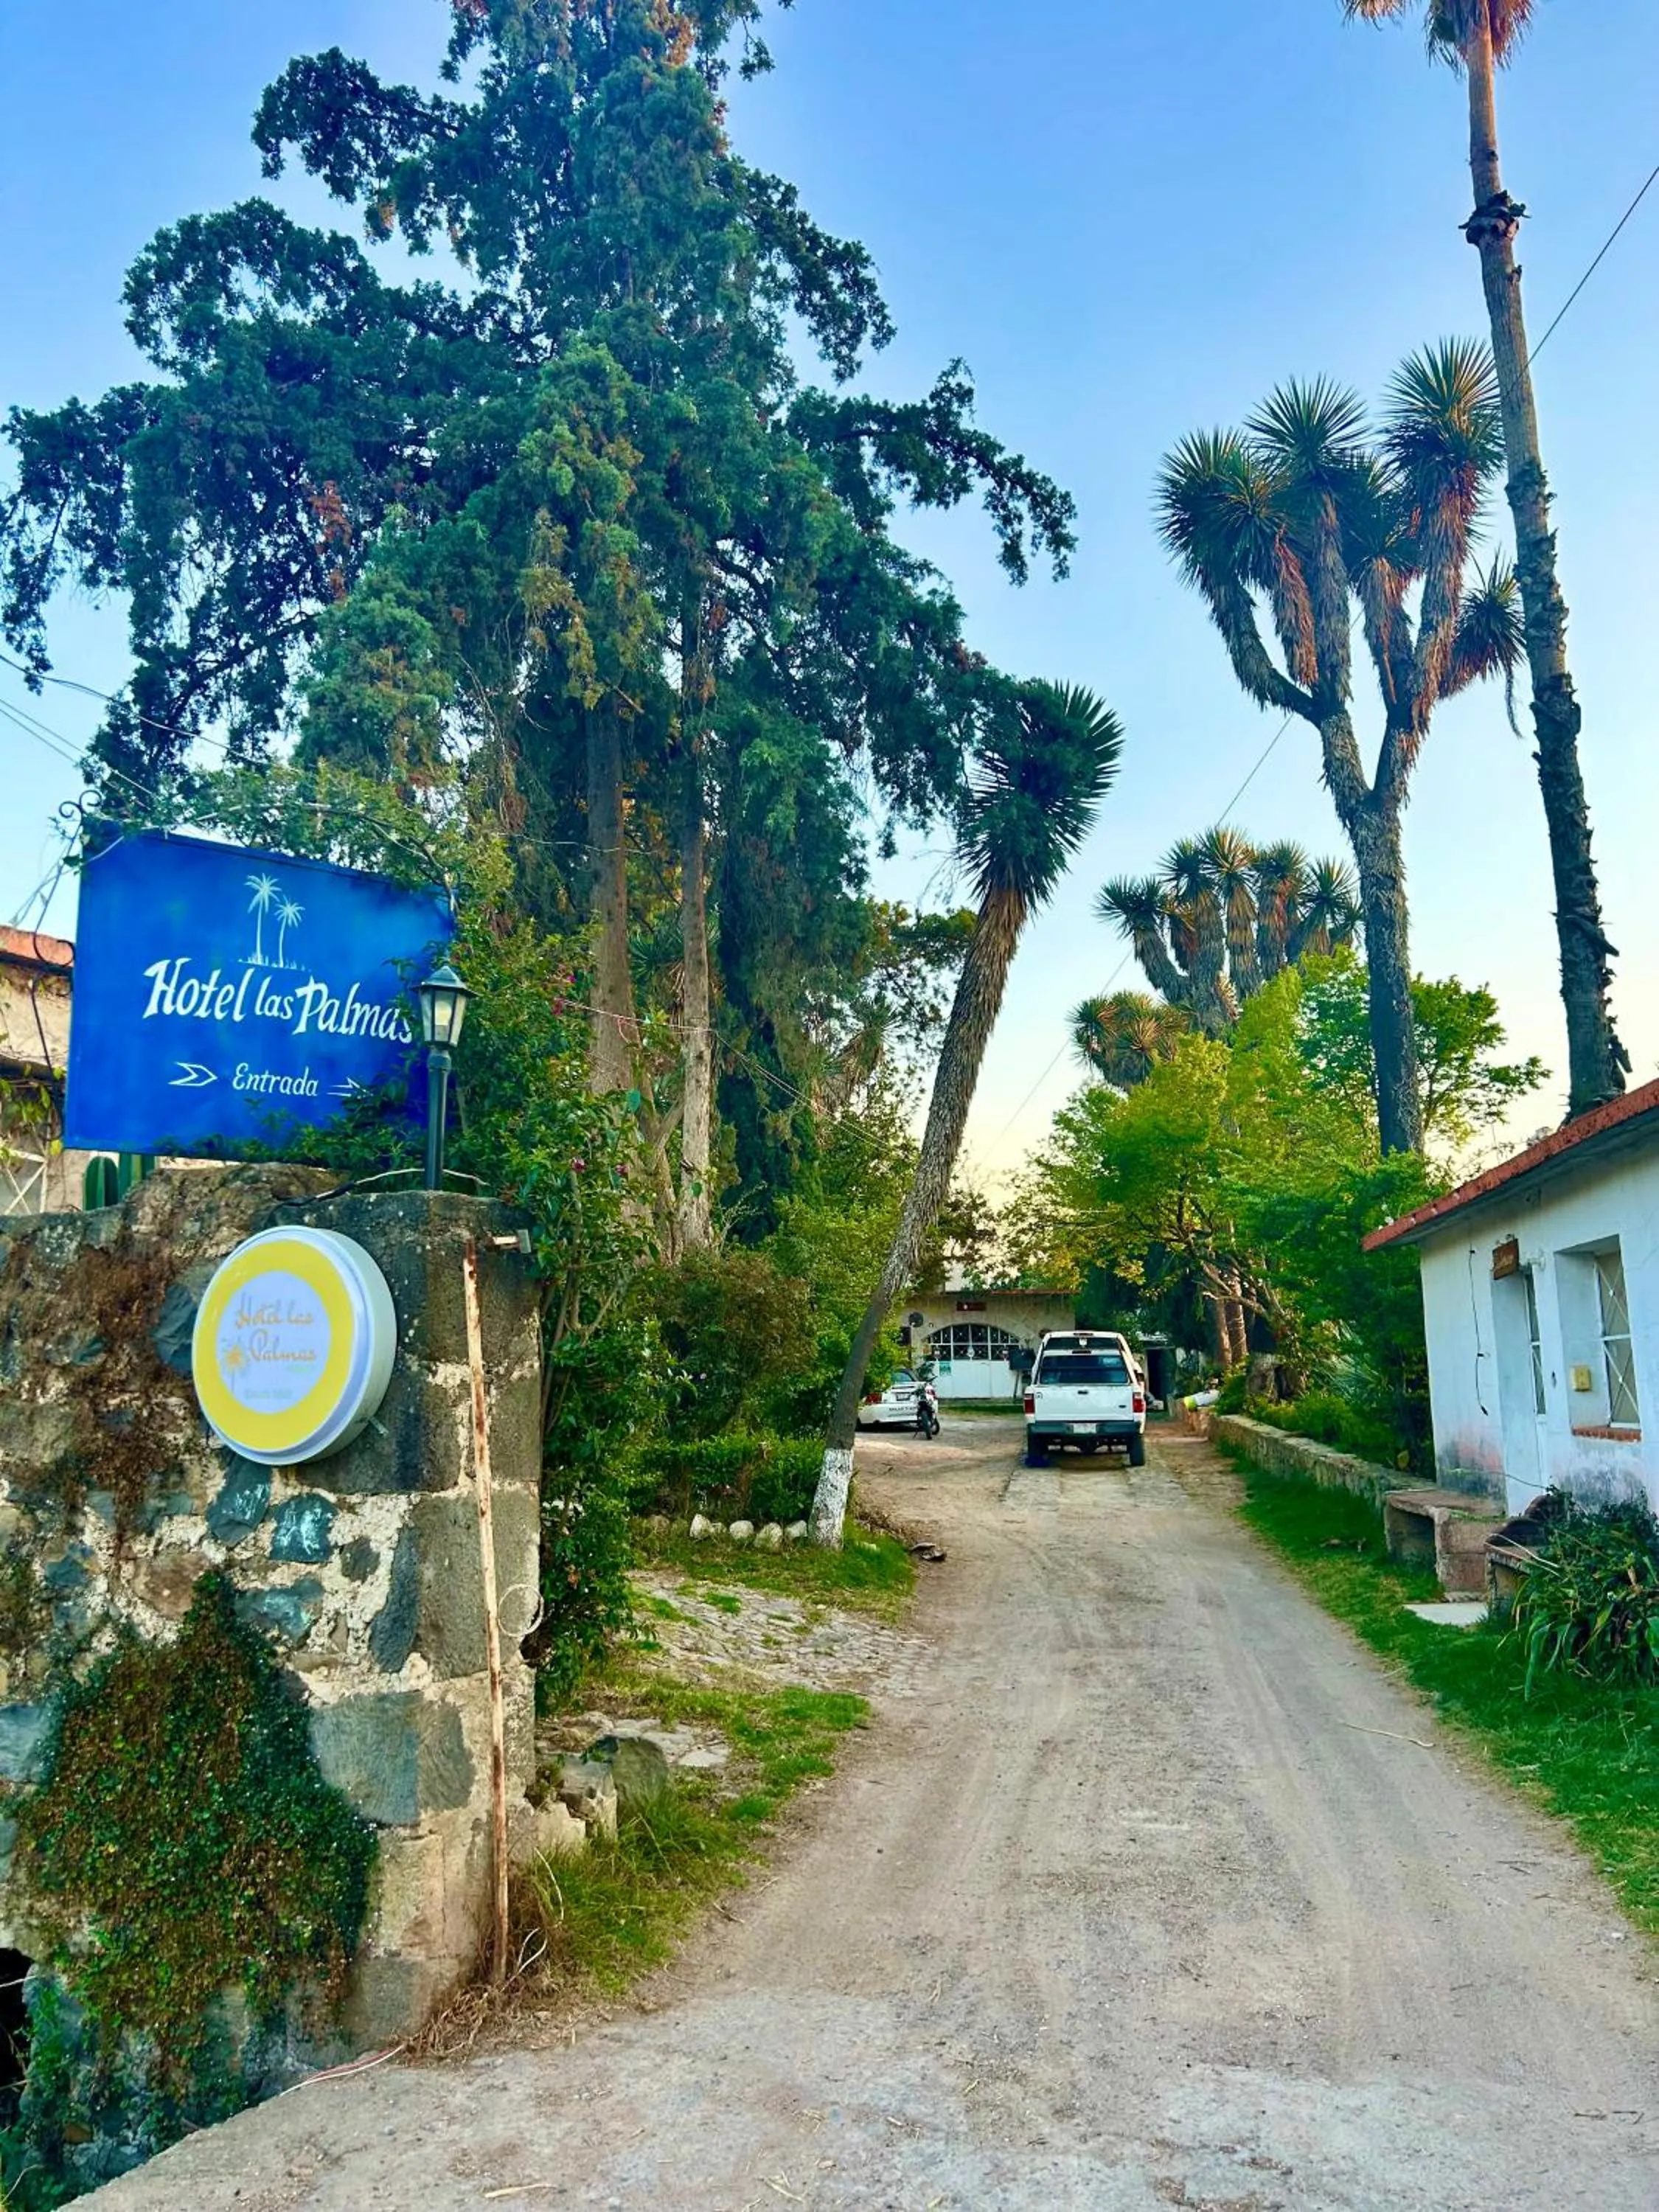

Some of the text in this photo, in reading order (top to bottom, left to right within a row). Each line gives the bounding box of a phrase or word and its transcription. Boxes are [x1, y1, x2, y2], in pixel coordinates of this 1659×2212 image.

[144, 958, 412, 1043] Hotel las Palmas
[232, 1062, 319, 1097] Entrada
[235, 1292, 282, 1329] Hotel
[250, 1329, 316, 1361] Palmas
